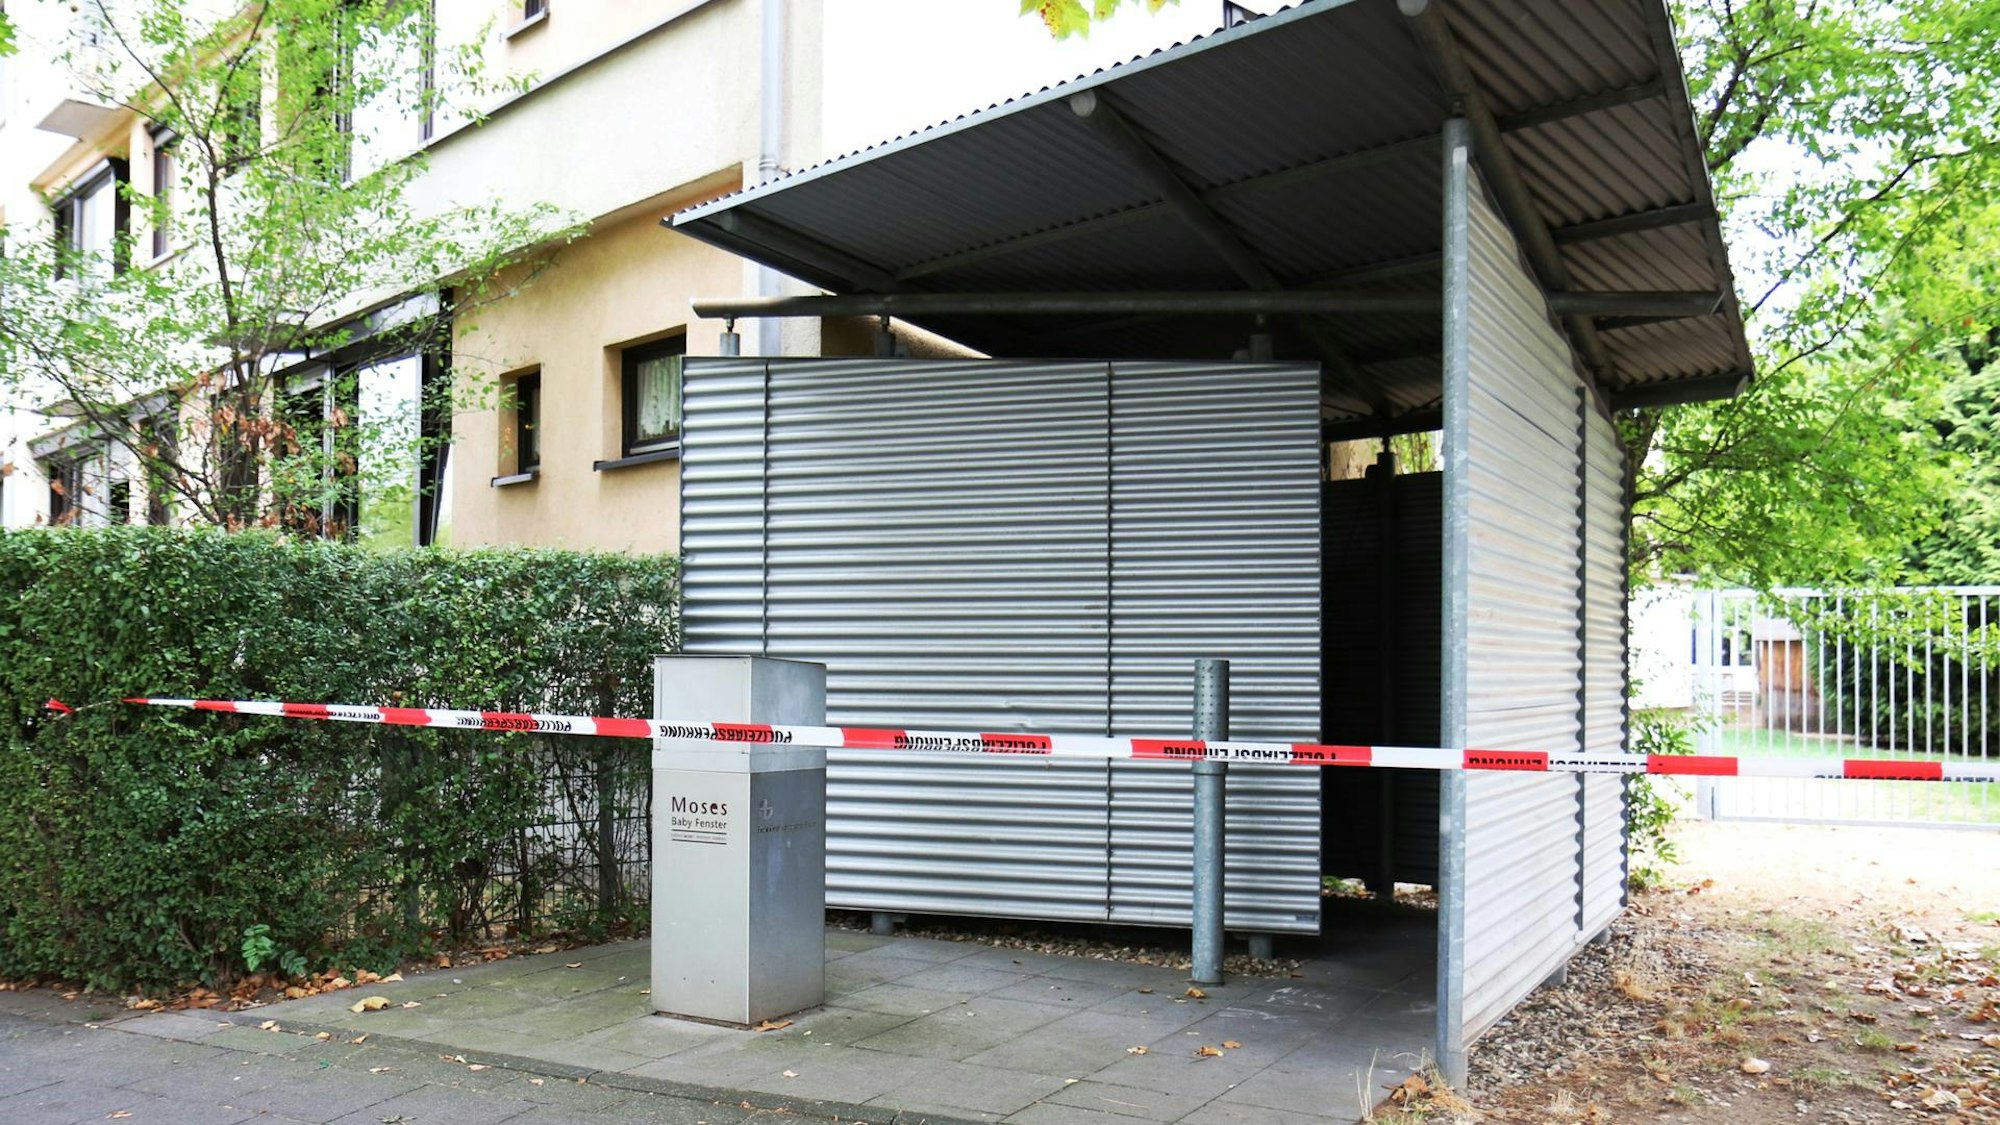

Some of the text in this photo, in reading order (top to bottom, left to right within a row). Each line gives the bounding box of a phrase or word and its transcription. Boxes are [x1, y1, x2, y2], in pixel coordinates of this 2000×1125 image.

[659, 725, 792, 743] POLIZEIABSPERRUNG
[671, 796, 728, 816] Moses
[671, 816, 728, 829] Baby Fenster
